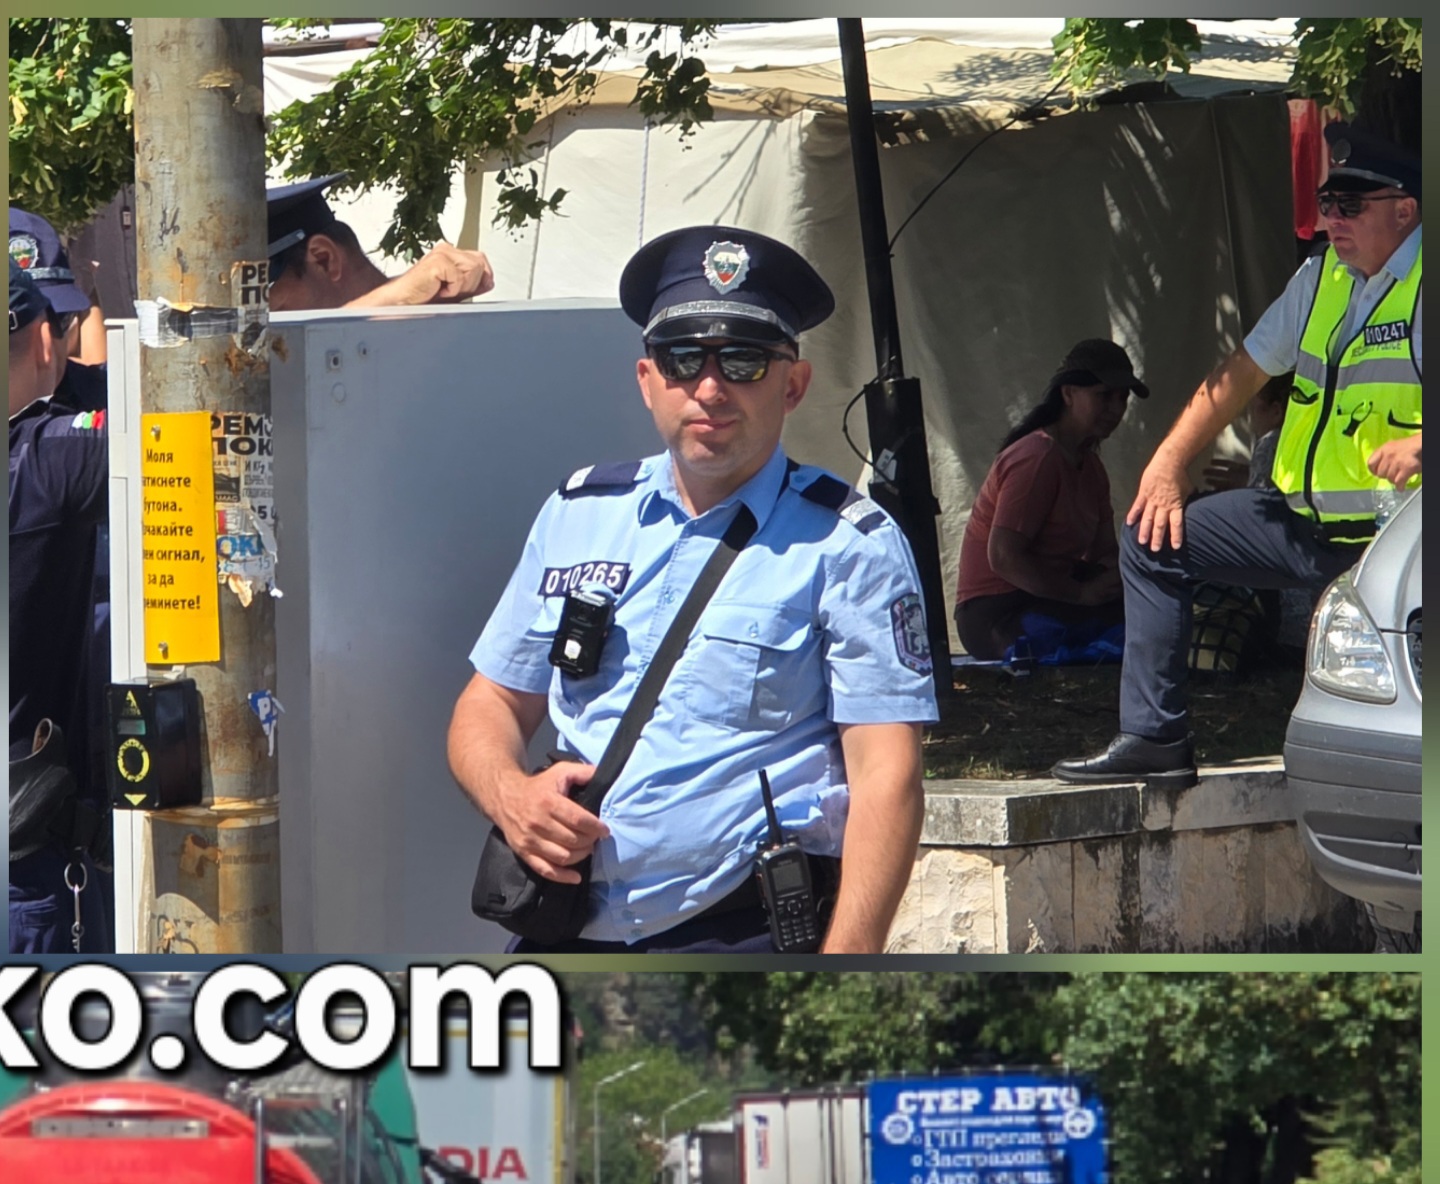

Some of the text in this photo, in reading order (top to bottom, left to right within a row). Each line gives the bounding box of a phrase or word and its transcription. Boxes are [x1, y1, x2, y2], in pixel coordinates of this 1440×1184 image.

[146, 448, 174, 464] Моля
[156, 549, 206, 563] сигнал,
[159, 574, 175, 588] да
[545, 562, 625, 595] 010265
